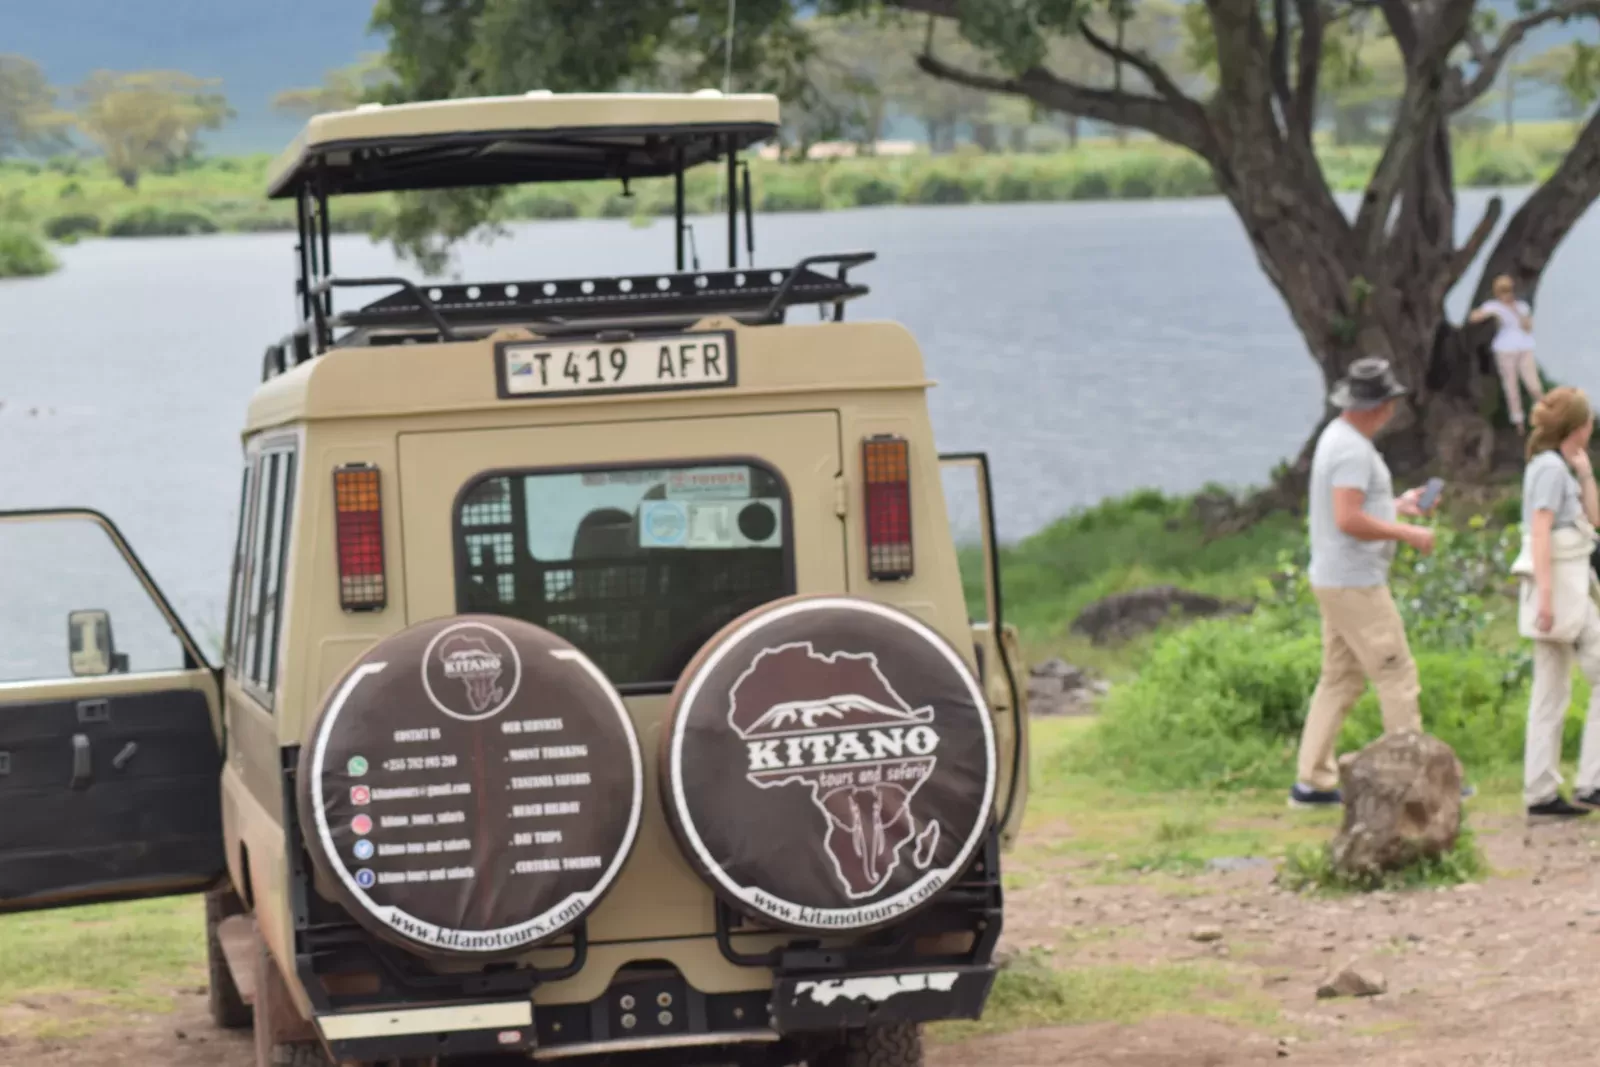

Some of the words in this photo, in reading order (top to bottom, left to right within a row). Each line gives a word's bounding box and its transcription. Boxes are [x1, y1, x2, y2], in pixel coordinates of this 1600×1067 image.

[534, 353, 552, 385] T
[564, 347, 628, 384] 419
[657, 342, 721, 378] AFR
[444, 659, 501, 673] KITANO
[746, 725, 940, 771] KITANO
[818, 770, 854, 788] tours
[858, 764, 882, 783] and
[753, 875, 944, 926] www.kitanotours.com
[389, 898, 586, 949] www.kitanotours.com
